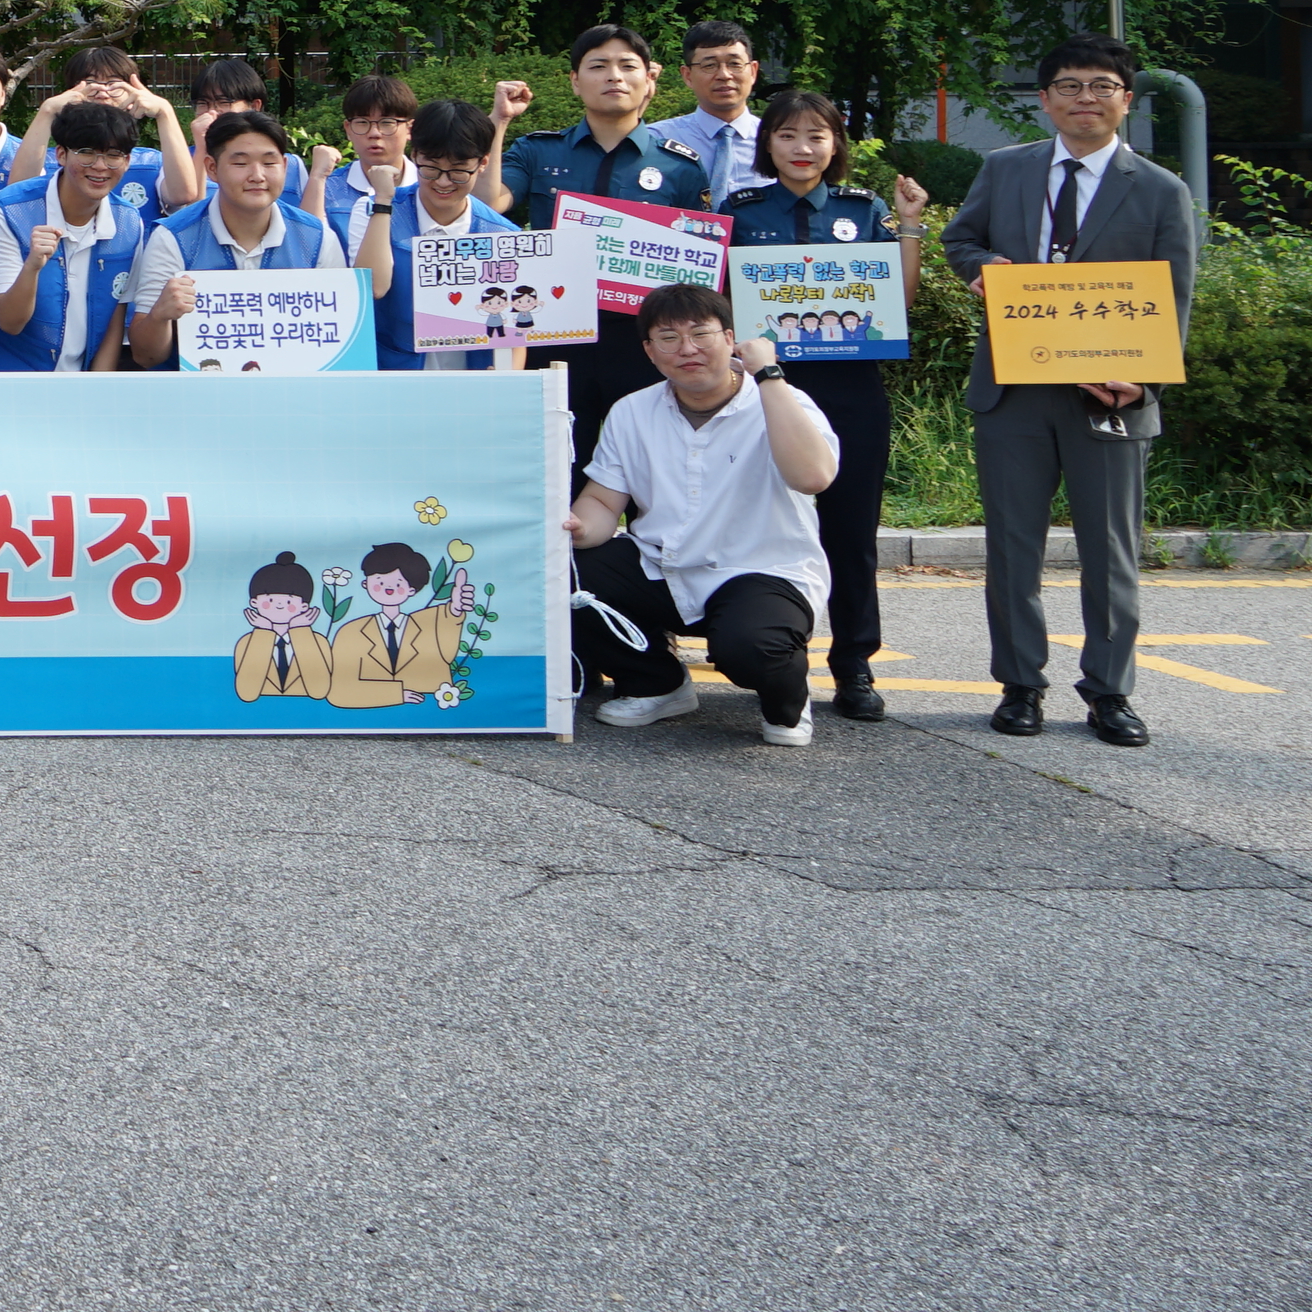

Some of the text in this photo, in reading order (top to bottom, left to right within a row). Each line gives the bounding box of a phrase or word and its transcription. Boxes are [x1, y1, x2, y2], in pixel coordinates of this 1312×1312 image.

[418, 233, 552, 262] 우리우정 영원히
[629, 240, 680, 263] 안전한
[684, 248, 718, 269] 학교
[419, 260, 519, 287] 넘치는 사랑
[608, 256, 641, 277] 함께
[741, 260, 890, 284] 학교폭력 없는 학교!
[760, 283, 875, 303] 나로부터 시작!
[1057, 283, 1075, 291] 예방
[1077, 282, 1086, 291] 및
[195, 291, 337, 318] 학교폭력 예방하니
[1004, 300, 1161, 320] 2024 우수학교
[196, 321, 341, 350] 웃음꽃핀 우리학교
[1055, 349, 1143, 359] 경기도의정부교육지원청
